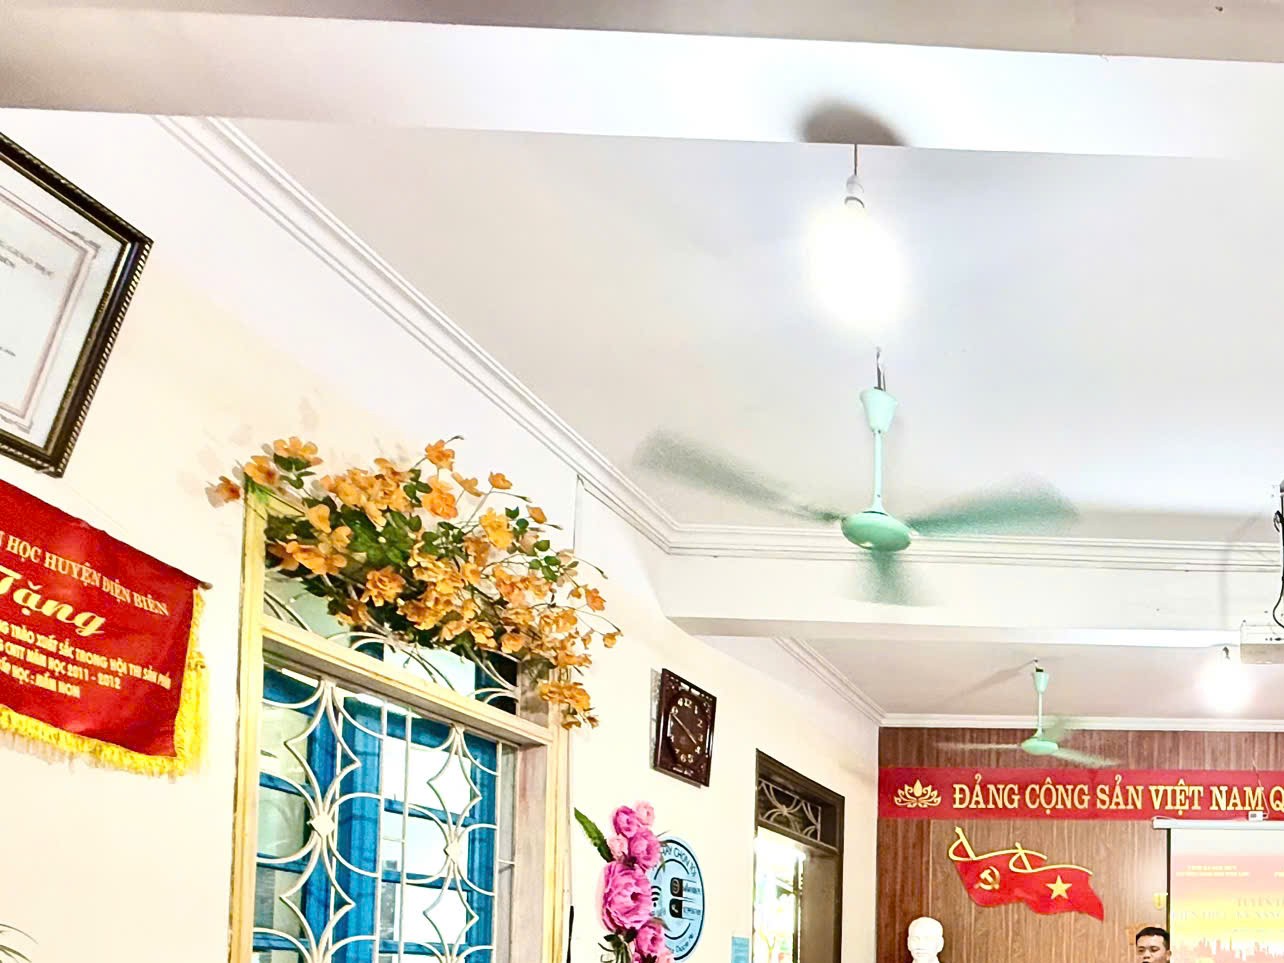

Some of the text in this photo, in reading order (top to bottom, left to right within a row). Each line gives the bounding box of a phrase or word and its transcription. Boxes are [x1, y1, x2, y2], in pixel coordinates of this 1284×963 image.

[6, 535, 42, 562] HỌC
[44, 551, 101, 586] HUYỆN
[132, 591, 169, 616] BIÊN
[953, 774, 1020, 809] ĐẢNG
[1025, 777, 1090, 815] CỘNG
[1096, 774, 1143, 810] SẢN
[1149, 779, 1203, 816] VIỆT
[1210, 786, 1264, 811] NAM
